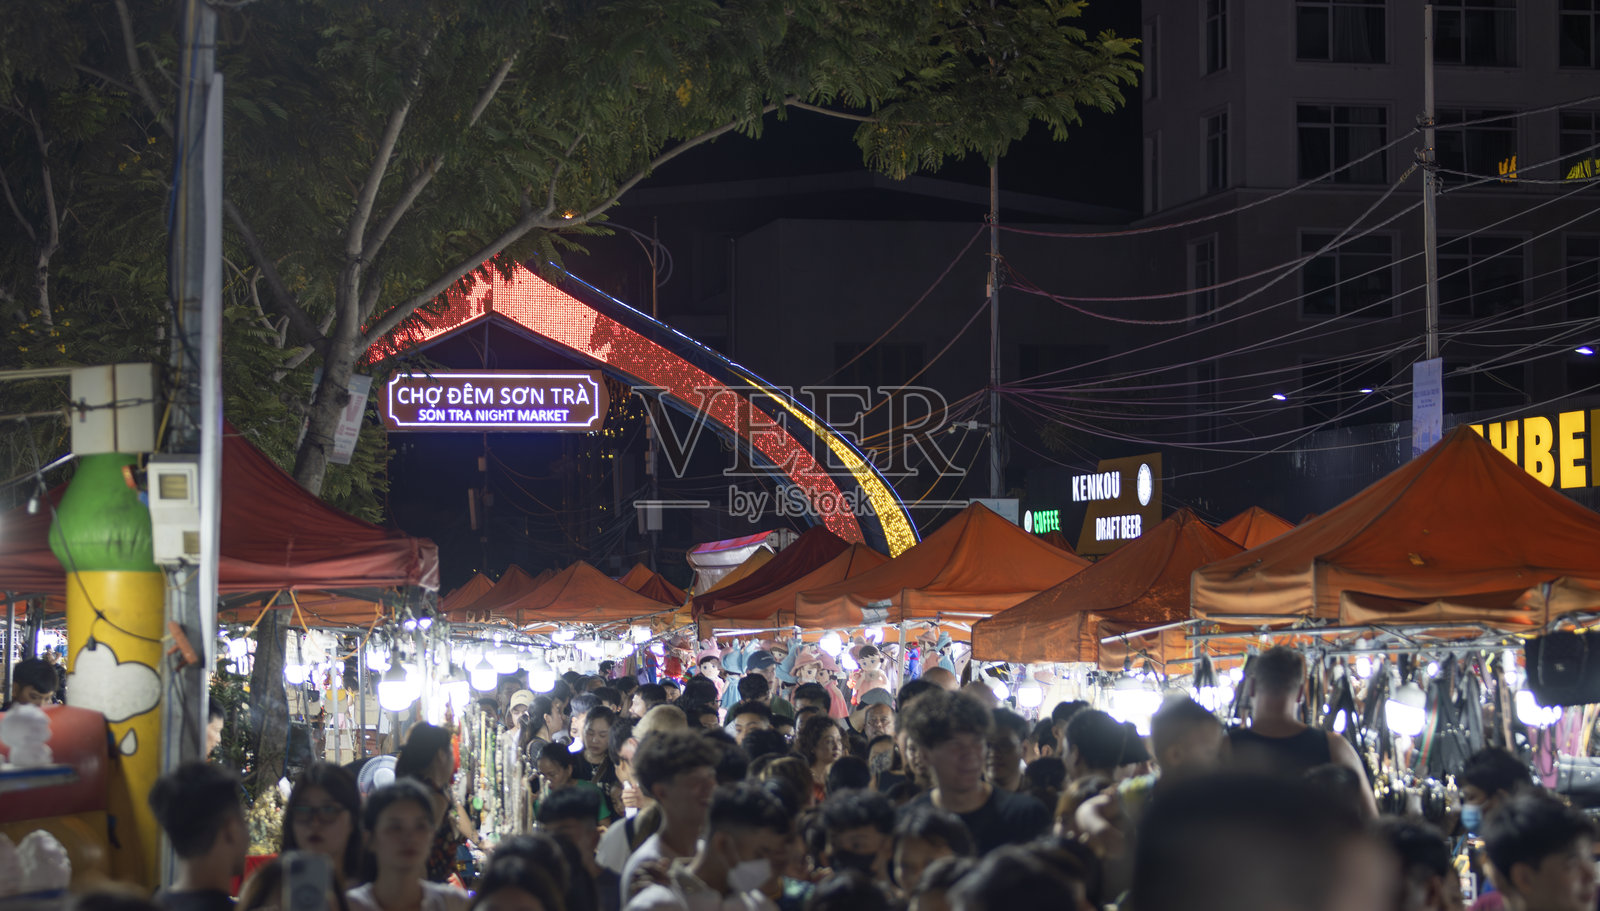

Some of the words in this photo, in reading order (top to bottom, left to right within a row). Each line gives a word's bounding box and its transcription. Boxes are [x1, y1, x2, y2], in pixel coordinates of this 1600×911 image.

[397, 385, 443, 408] CHỢ
[447, 382, 494, 405] ĐÊM
[500, 386, 544, 405] SƠN
[550, 383, 590, 405] TRÀ
[448, 409, 473, 422] TRA
[475, 409, 515, 422] NIGHT
[518, 409, 569, 422] MARKET
[1072, 471, 1120, 502] KENKOU
[1033, 510, 1060, 534] COFFEE
[1096, 516, 1120, 541] DRAFT
[1121, 514, 1142, 539] BEER
